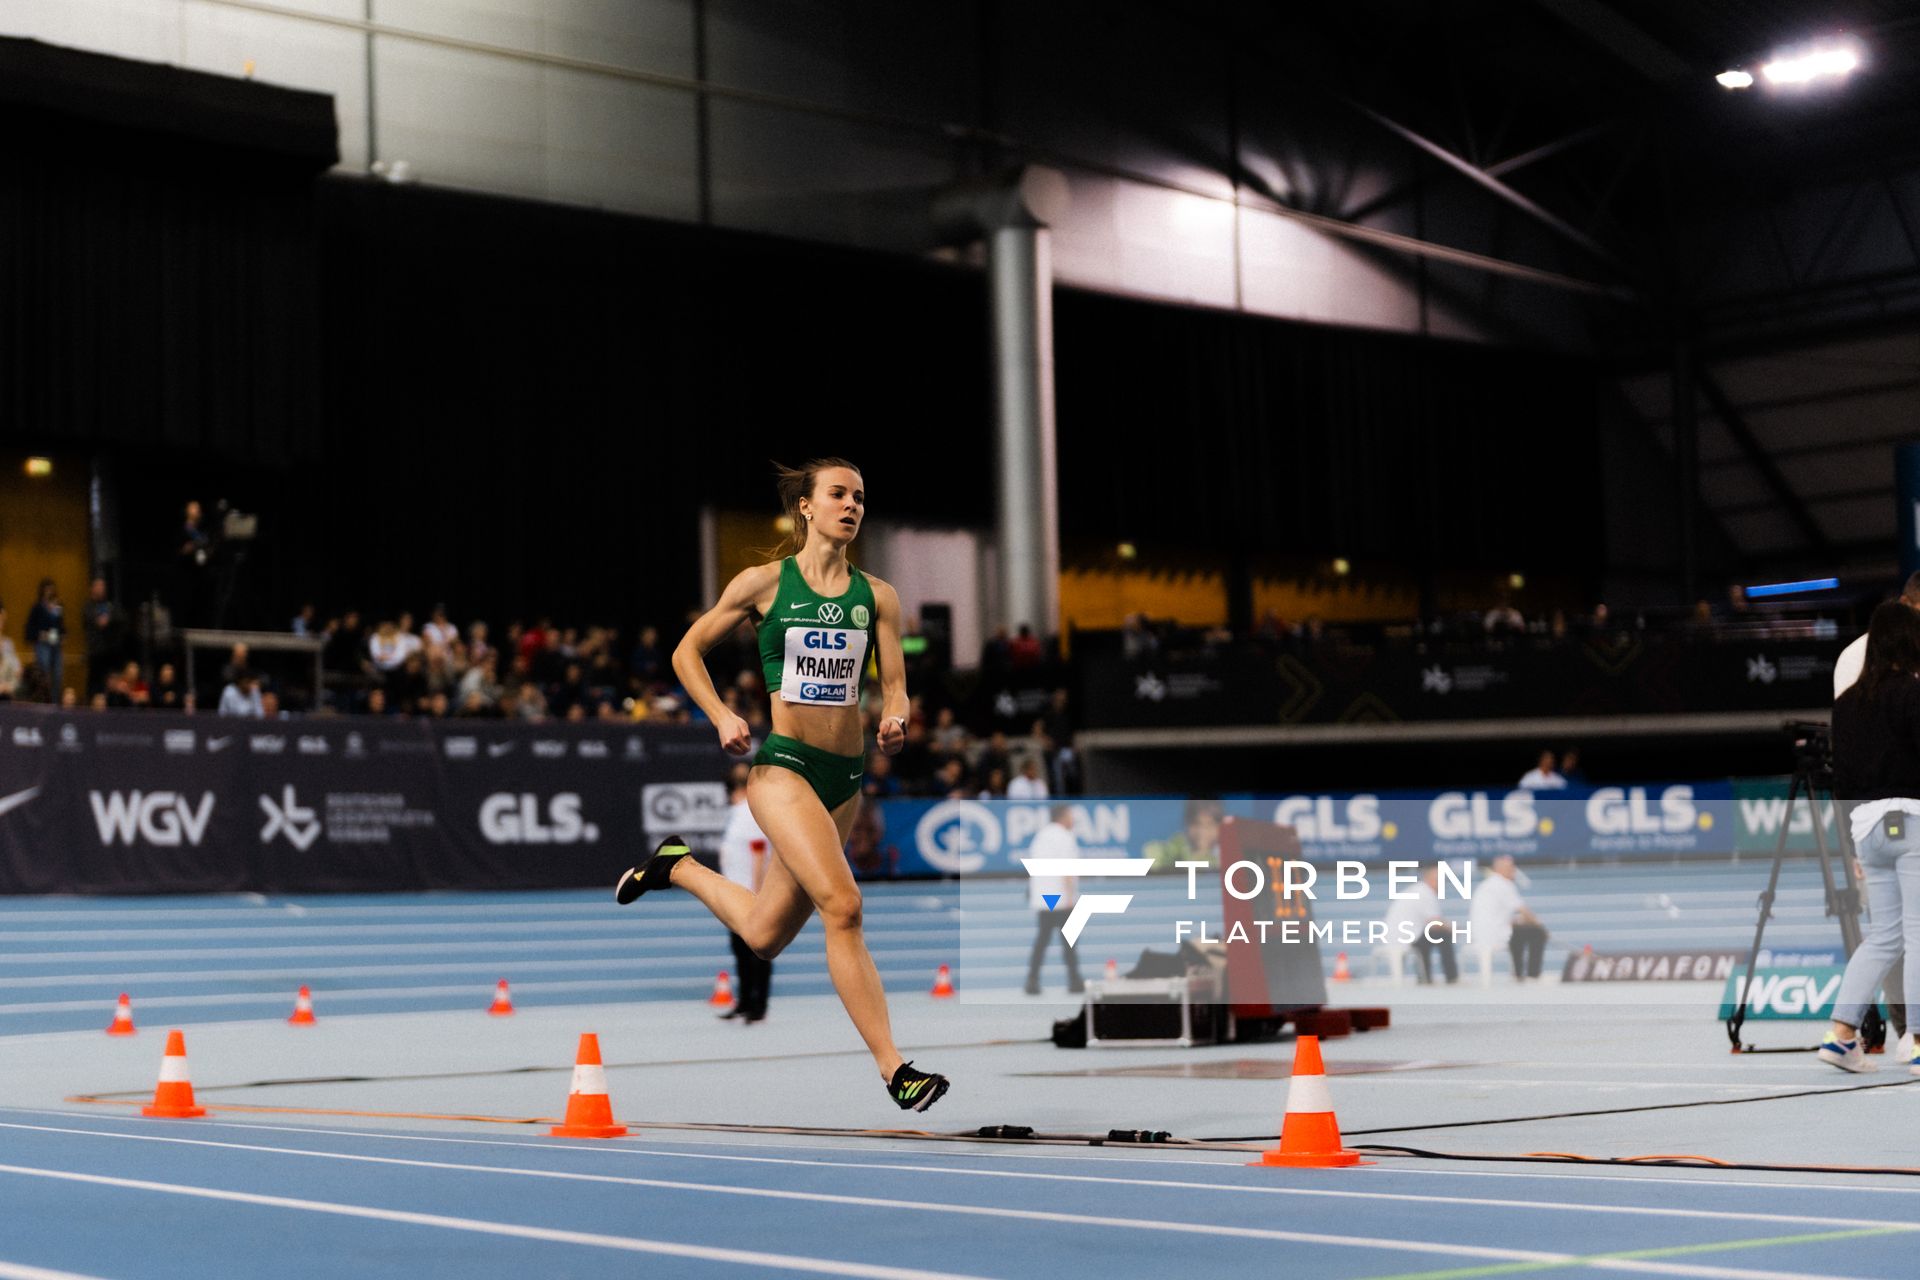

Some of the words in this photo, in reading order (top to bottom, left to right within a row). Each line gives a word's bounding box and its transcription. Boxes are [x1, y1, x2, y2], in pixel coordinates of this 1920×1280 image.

[796, 655, 855, 679] KRAMER
[820, 687, 845, 695] PLAN
[90, 790, 214, 845] WGV
[479, 793, 598, 843] GLS.
[1274, 795, 1398, 840] GLS.
[1428, 791, 1555, 838] GLS.
[1586, 785, 1713, 834] GLS.
[1593, 955, 1735, 979] NOVAFON
[1735, 974, 1842, 1014] WGV
